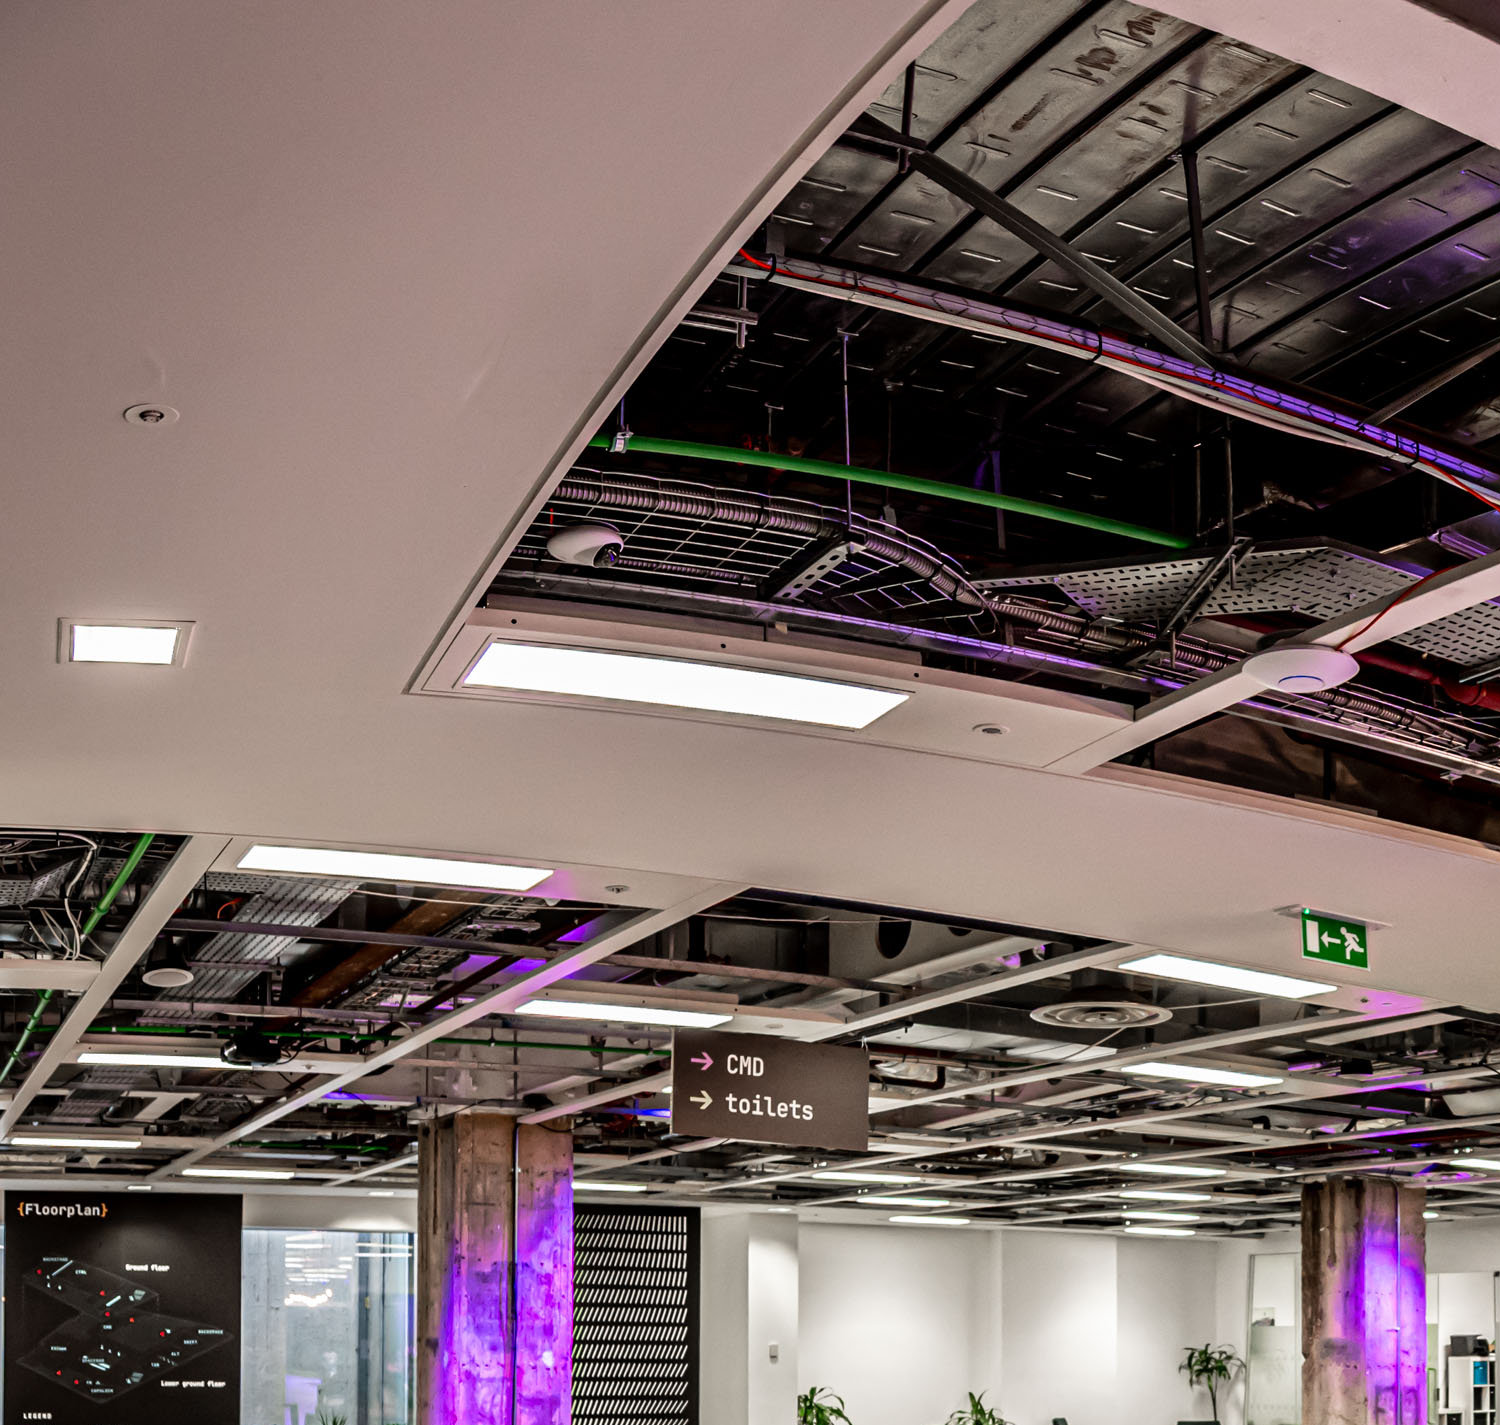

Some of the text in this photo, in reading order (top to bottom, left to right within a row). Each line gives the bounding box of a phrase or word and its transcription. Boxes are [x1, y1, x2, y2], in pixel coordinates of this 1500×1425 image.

[726, 1054, 765, 1077] CMD
[725, 1093, 814, 1121] toilets
[23, 1412, 53, 1420] LEGEND
